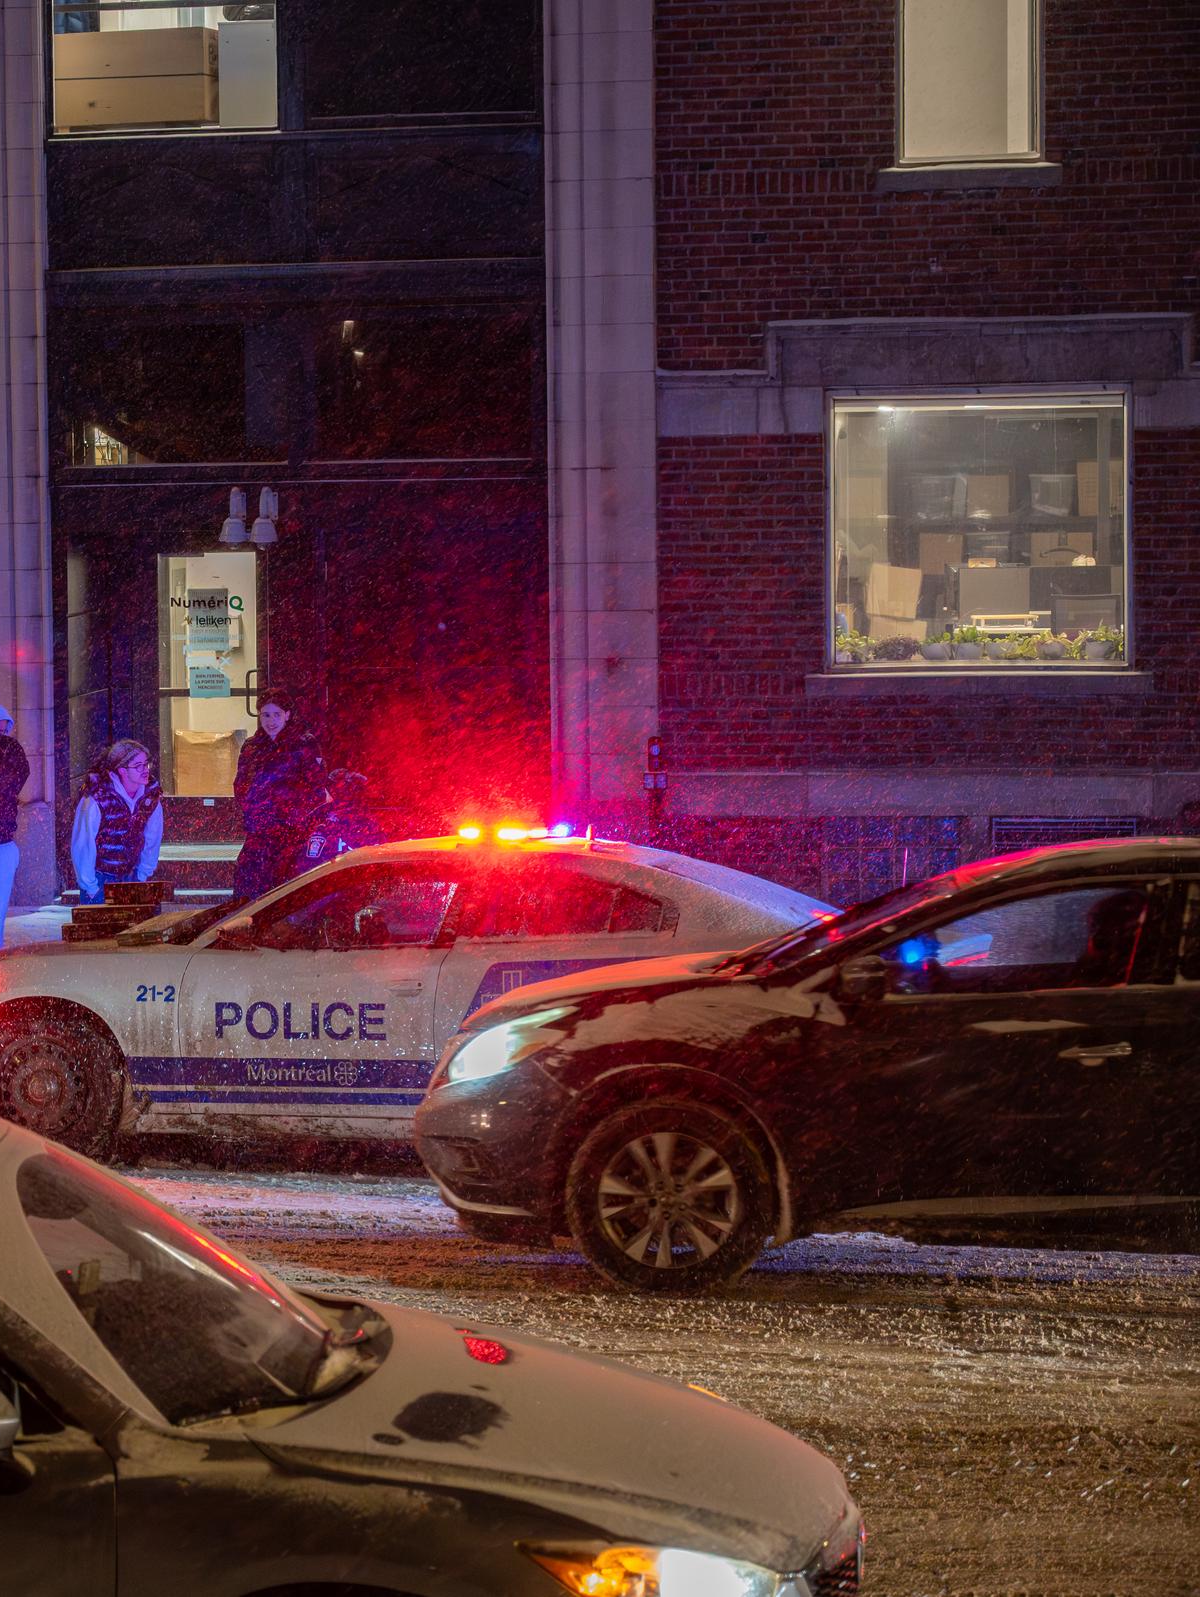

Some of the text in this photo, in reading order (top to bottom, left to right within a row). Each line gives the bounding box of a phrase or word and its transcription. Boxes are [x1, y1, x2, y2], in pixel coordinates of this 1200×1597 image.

[170, 595, 244, 611] NumériQ
[136, 985, 176, 1002] 21-2
[214, 1001, 387, 1040] POLICE
